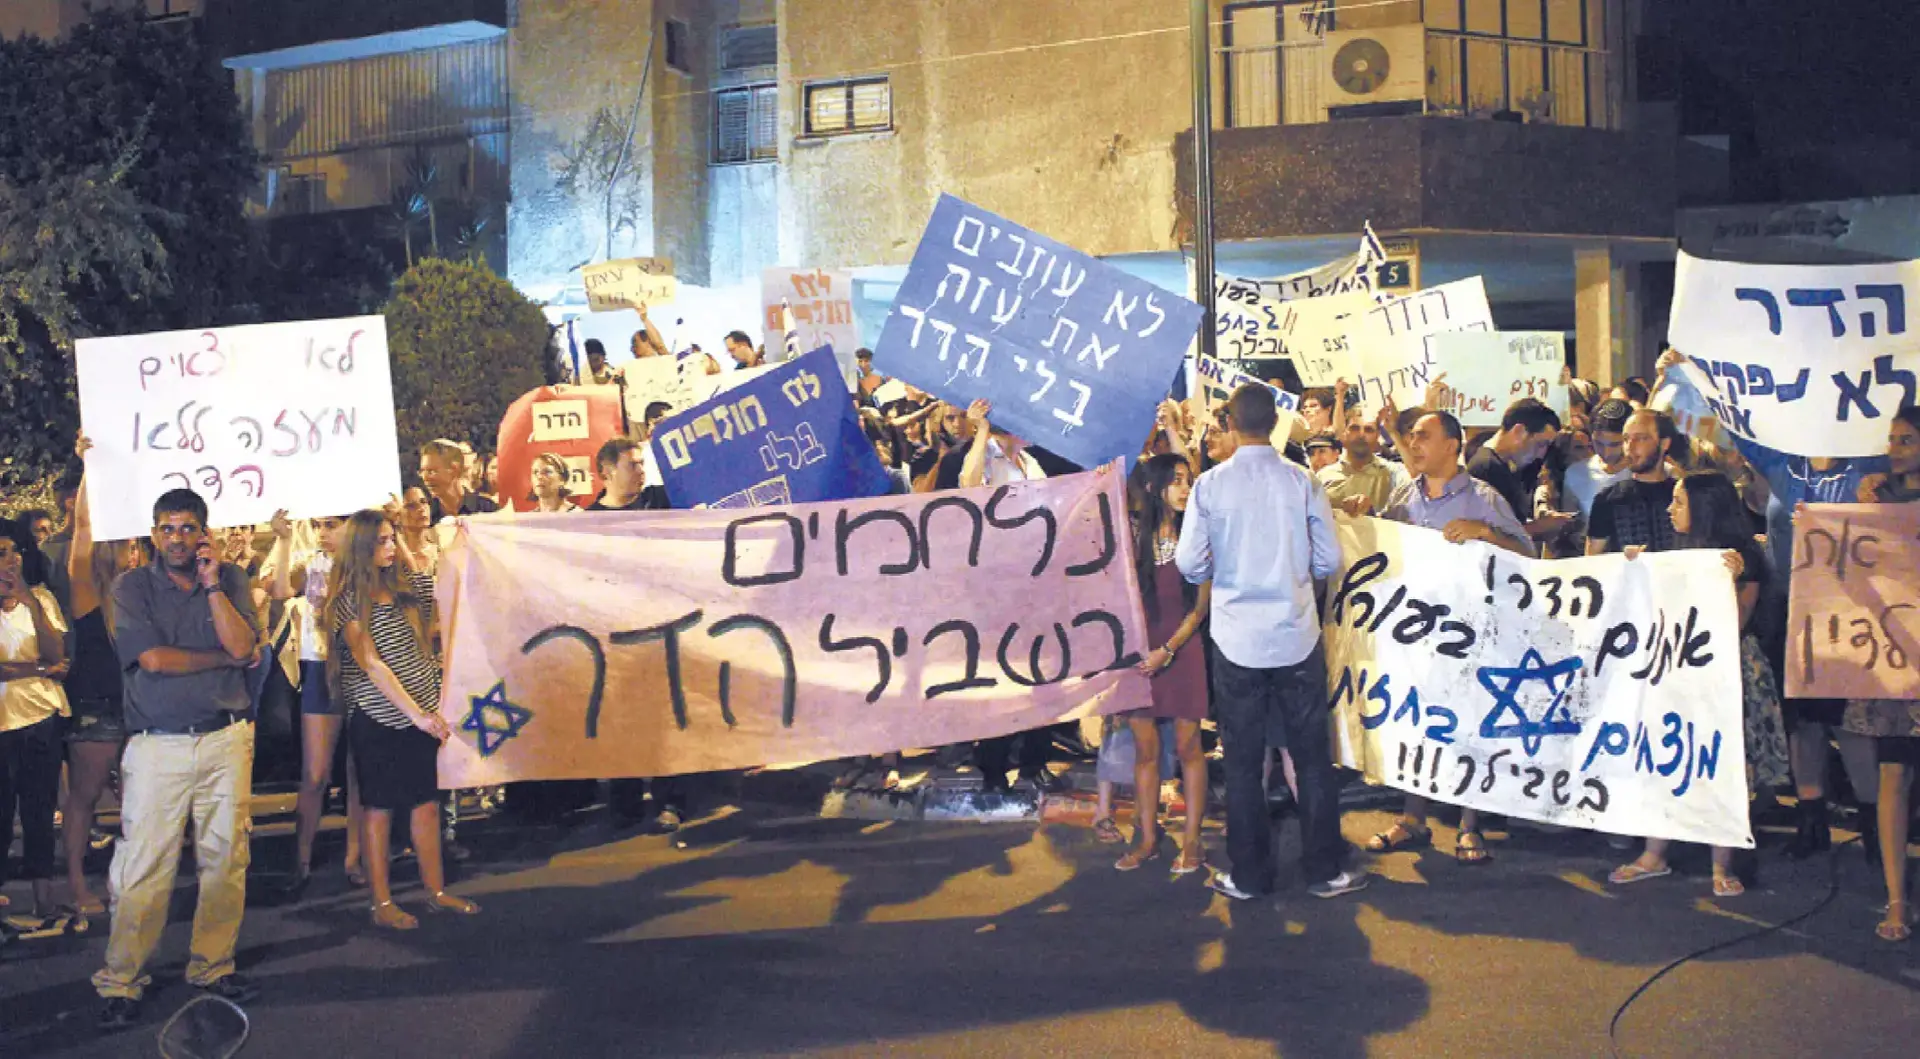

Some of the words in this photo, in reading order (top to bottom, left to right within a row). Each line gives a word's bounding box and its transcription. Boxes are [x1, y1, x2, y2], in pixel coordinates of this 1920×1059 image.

[953, 215, 1087, 300] עוזבים
[1388, 264, 1400, 284] 5
[935, 263, 1023, 325] עזה
[1102, 289, 1166, 337] לא
[1368, 289, 1450, 336] הדר
[1734, 284, 1907, 338] הדר
[900, 304, 992, 378] הדר
[1040, 315, 1121, 371] את
[538, 411, 582, 429] הדר
[1014, 354, 1093, 428] בלי
[1831, 354, 1917, 422] לא
[132, 400, 213, 452] ללא
[229, 406, 356, 457] מעזה
[722, 484, 1116, 587] נלחמים
[1793, 517, 1880, 582] את
[1332, 551, 1477, 660] בעורף
[521, 609, 797, 738] הדר
[819, 606, 1142, 703] בשביל
[1328, 665, 1459, 744] בחזית
[1579, 711, 1722, 797] מנצחים
